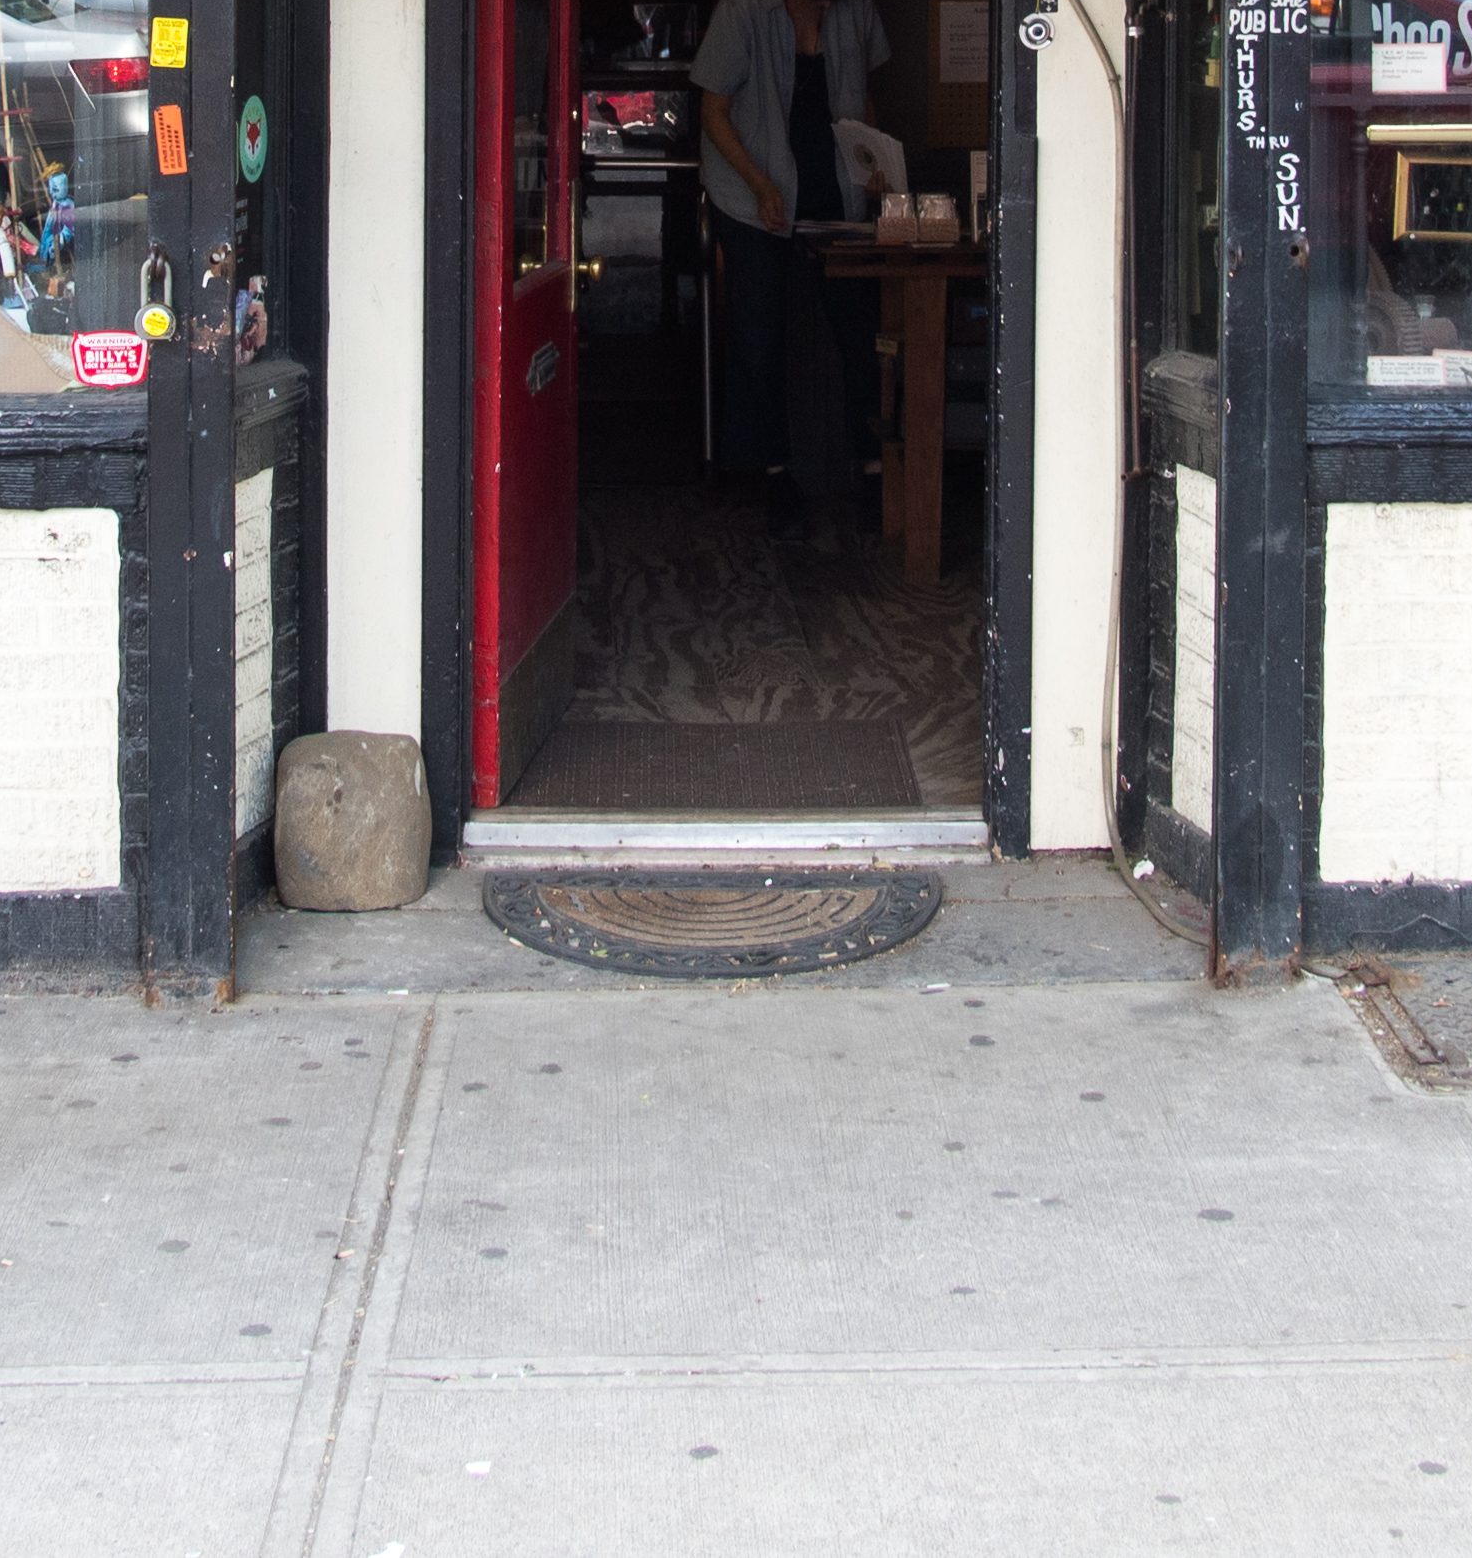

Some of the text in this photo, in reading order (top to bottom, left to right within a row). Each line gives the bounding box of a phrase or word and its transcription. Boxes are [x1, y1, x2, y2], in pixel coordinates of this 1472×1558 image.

[1229, 8, 1308, 34] PUBLIC
[1246, 136, 1289, 150] THRU
[1276, 153, 1307, 232] SUN.
[87, 337, 134, 345] WARNING
[85, 350, 136, 362] BILLY'S
